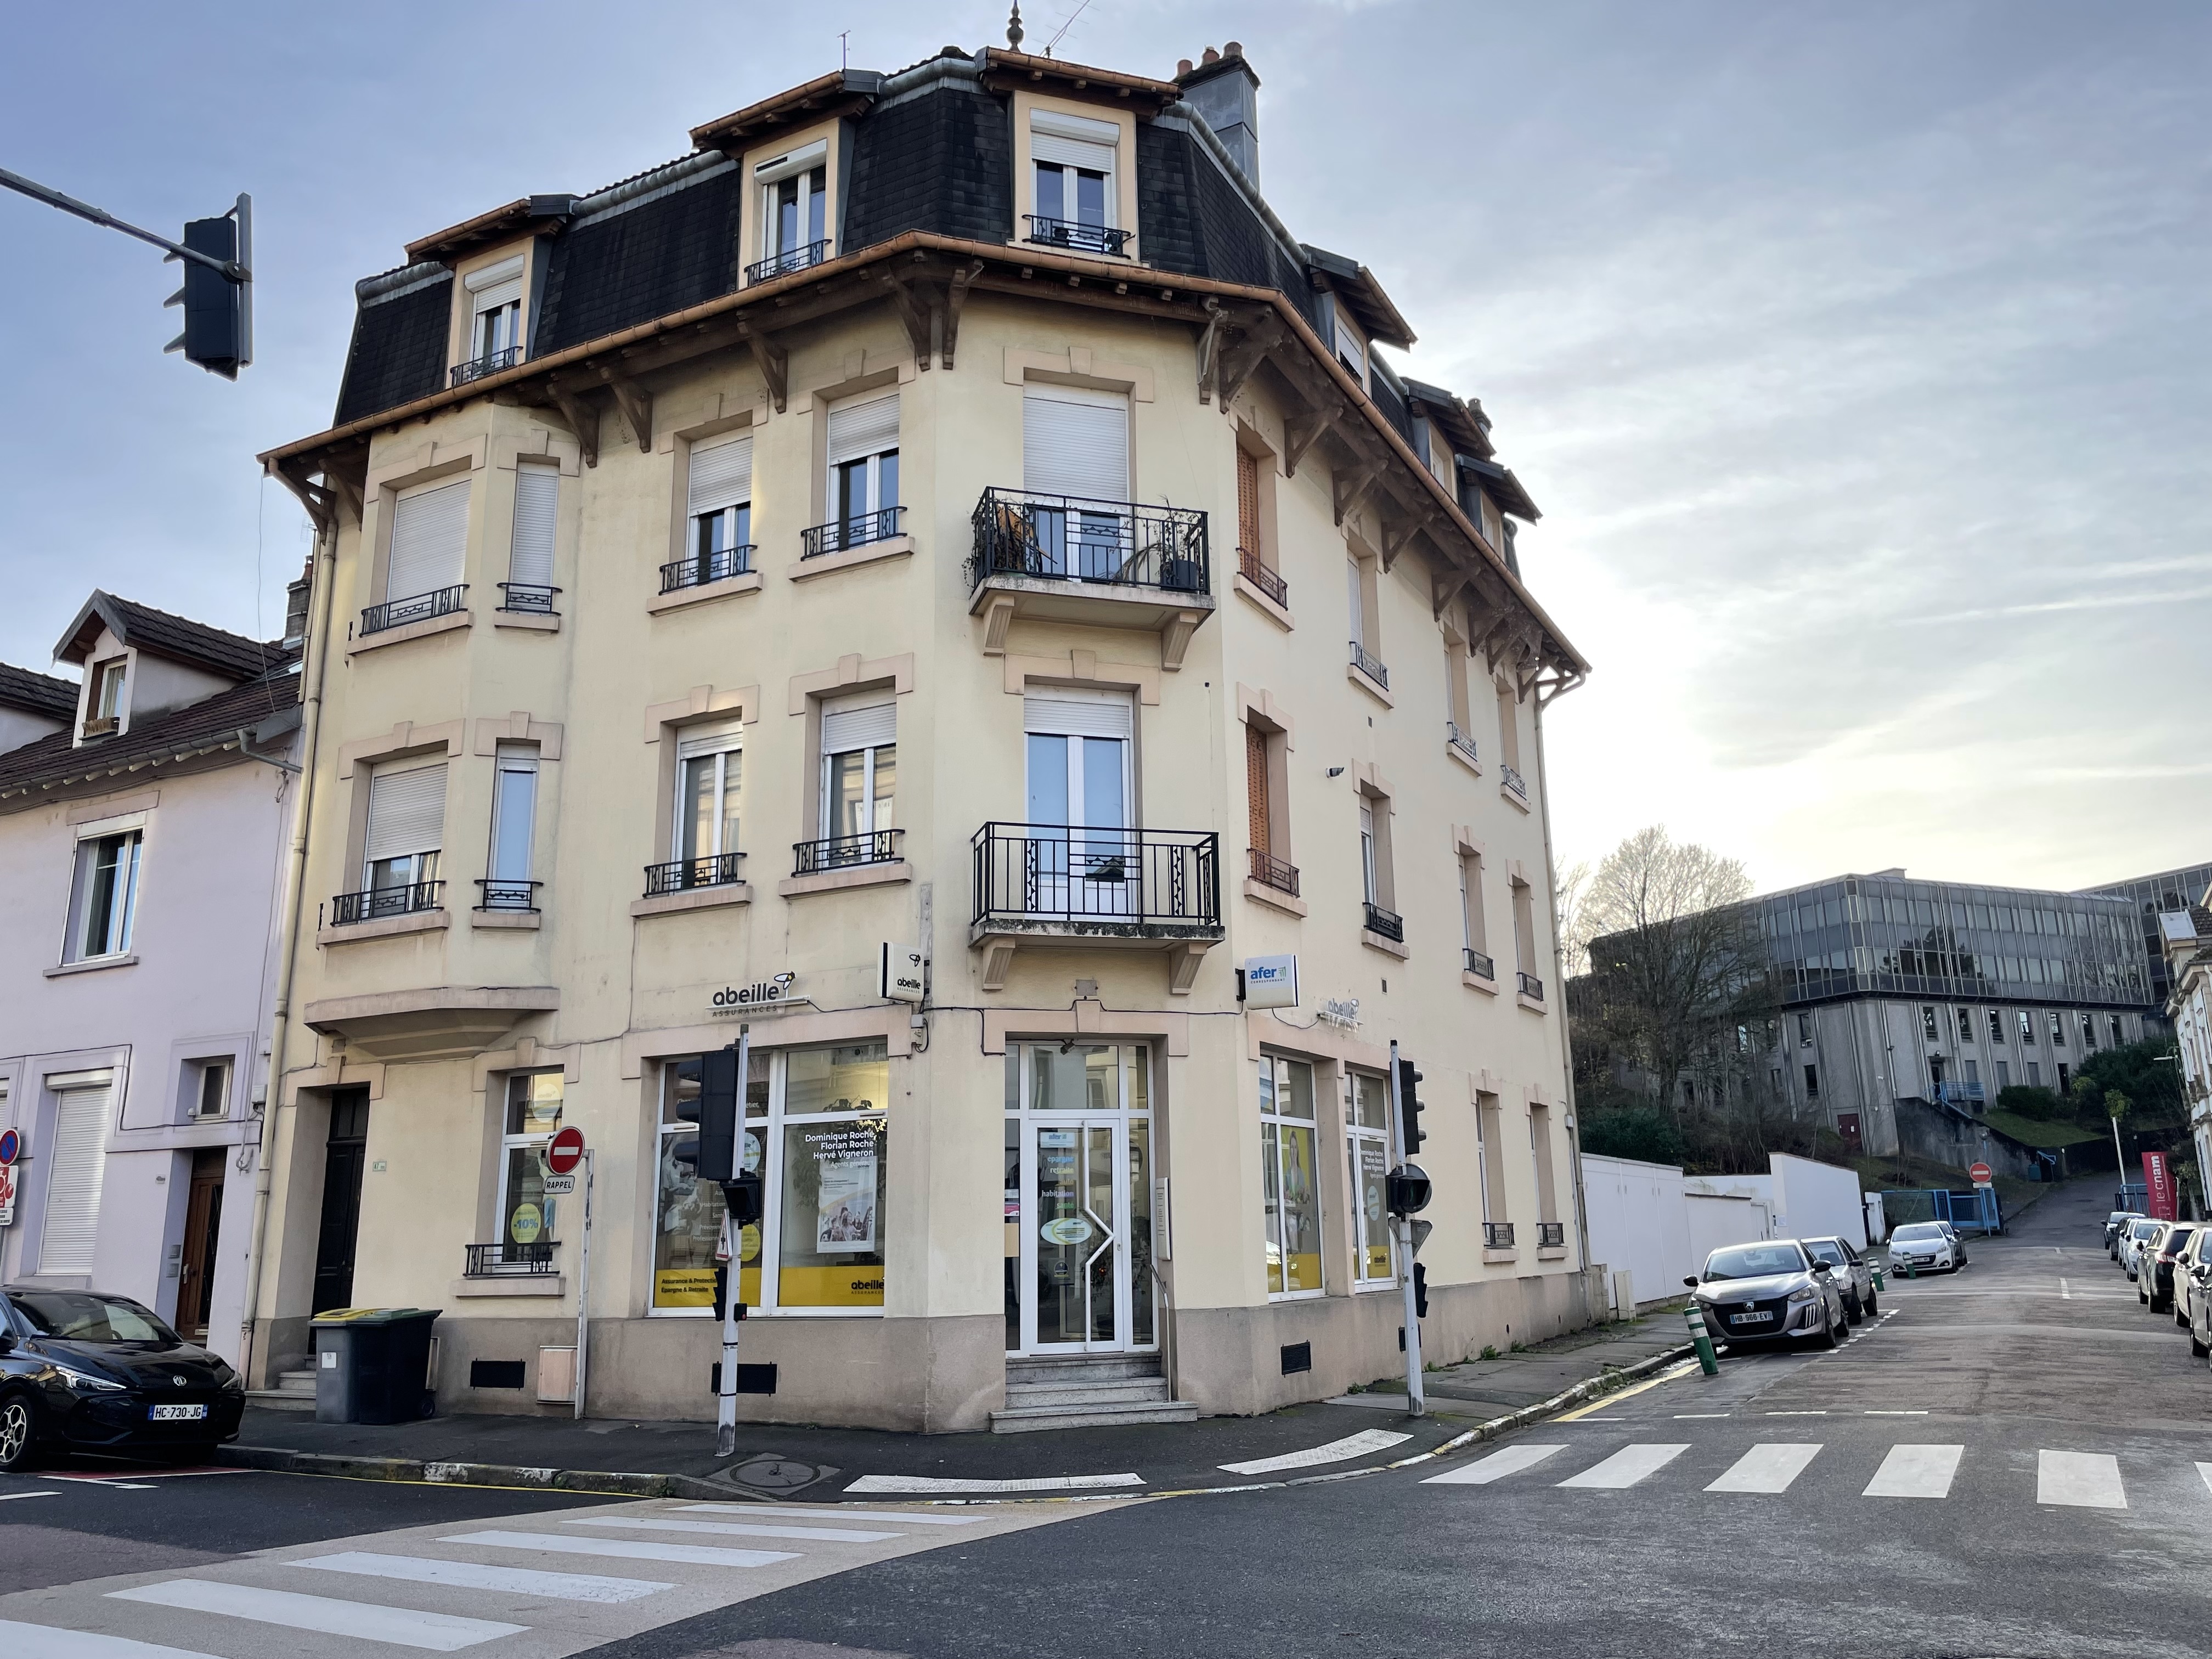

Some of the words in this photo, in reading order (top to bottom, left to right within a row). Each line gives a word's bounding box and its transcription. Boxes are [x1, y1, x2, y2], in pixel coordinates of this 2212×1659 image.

[1250, 967, 1277, 979] afer
[898, 977, 921, 989] abeille
[713, 983, 779, 1006] abeille
[712, 1005, 777, 1017] ASSURANCES
[1328, 998, 1355, 1019] abeille
[805, 1132, 848, 1143] Dominique
[821, 1142, 848, 1150] Florian
[850, 1139, 874, 1148] Roche
[813, 1150, 836, 1159] Hervé
[838, 1149, 874, 1159] Vigneron
[831, 1161, 849, 1169] Agents
[514, 1218, 538, 1229] -10%
[851, 1279, 884, 1289] abeille
[155, 1407, 201, 1418] HC-730-JG
